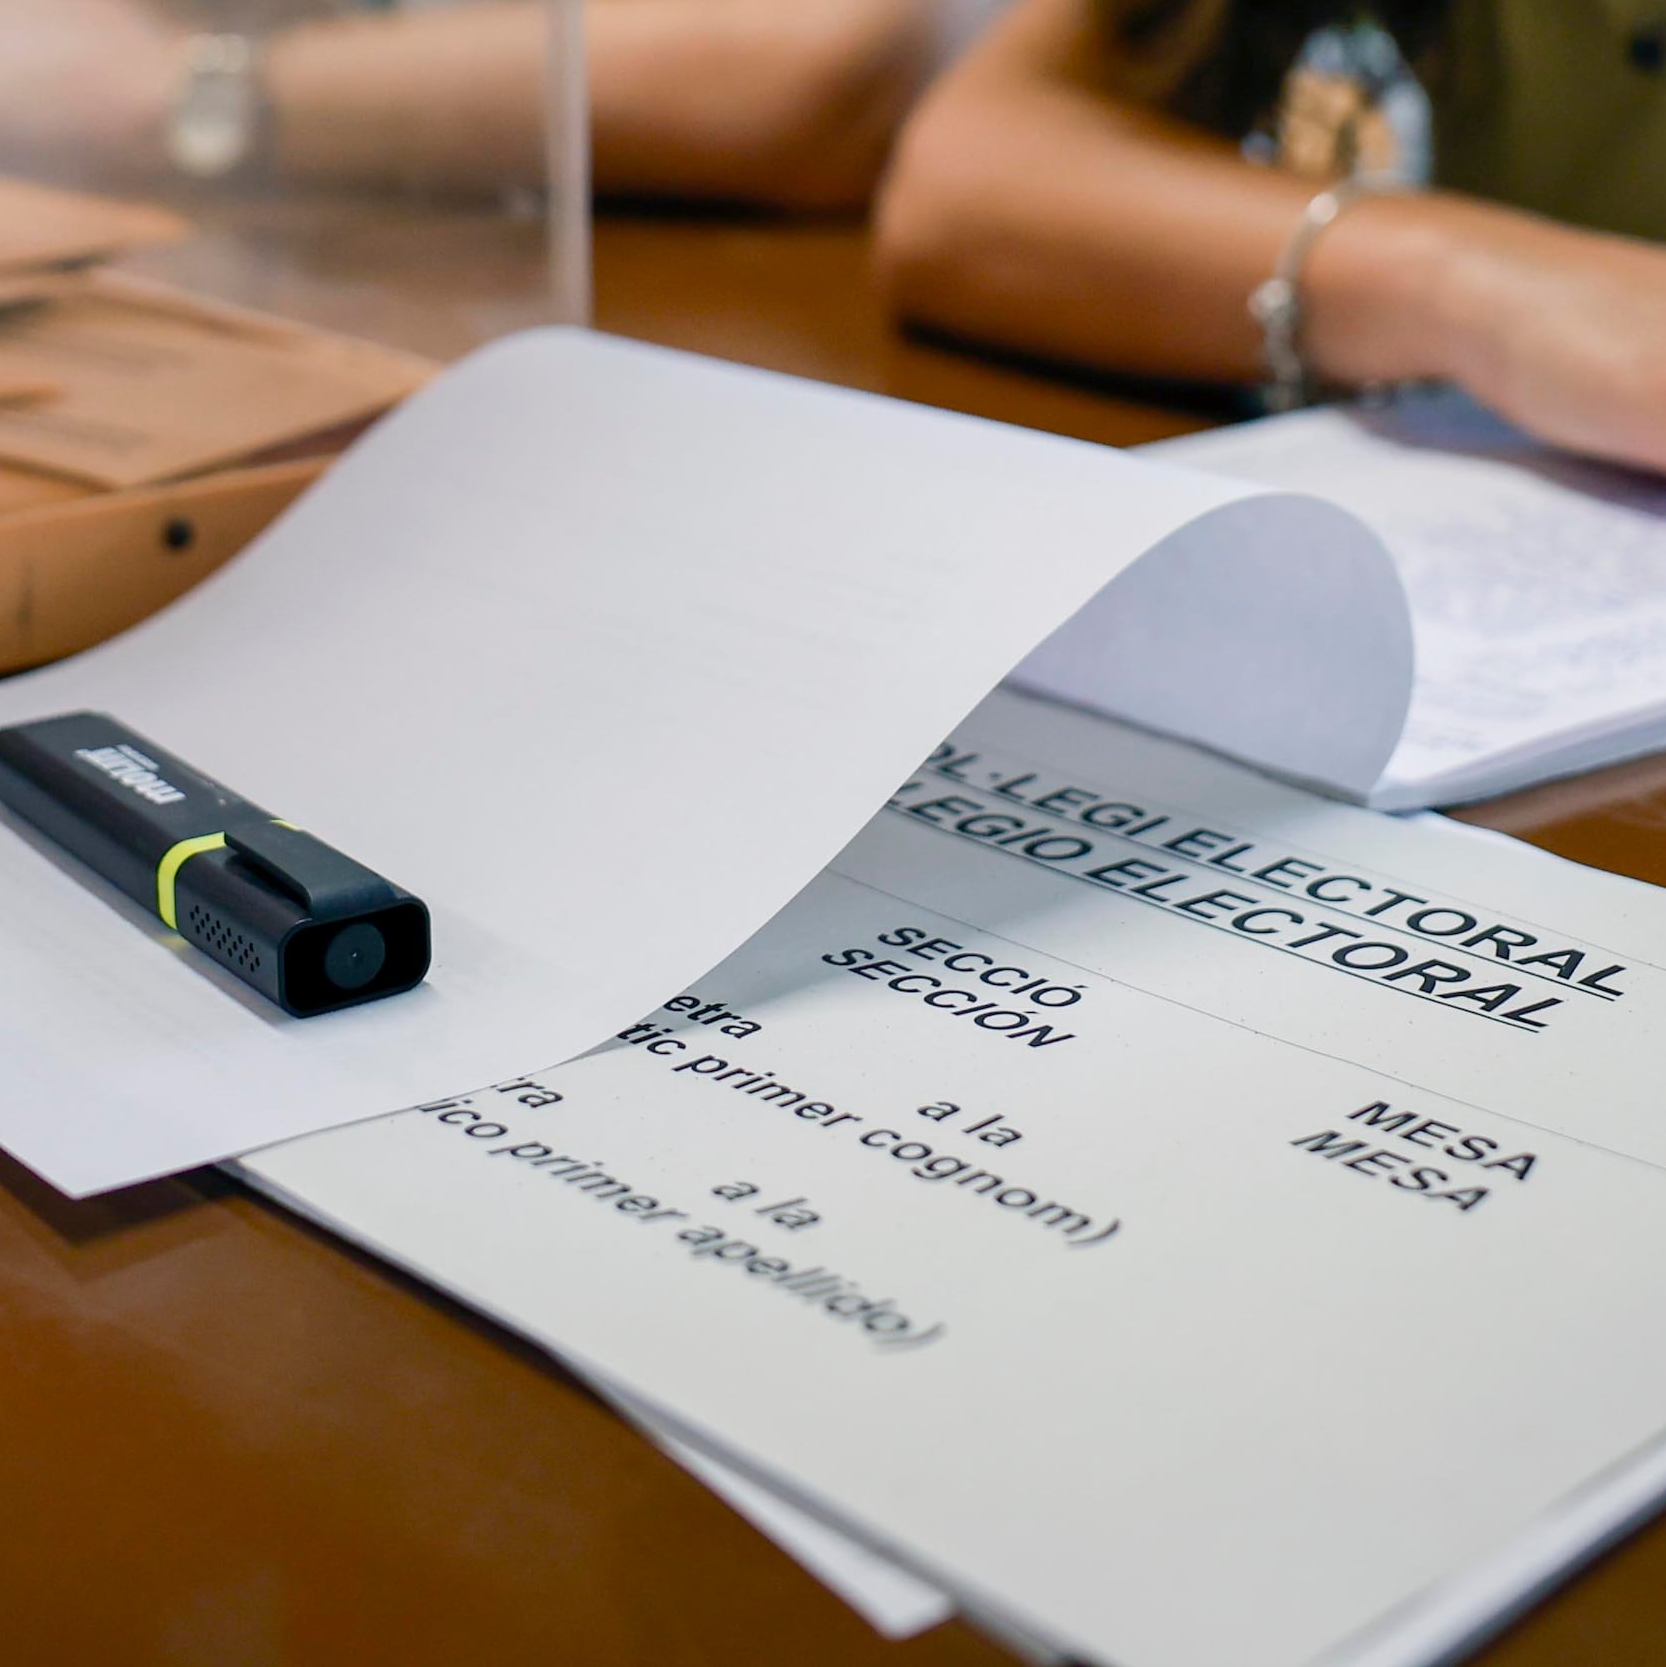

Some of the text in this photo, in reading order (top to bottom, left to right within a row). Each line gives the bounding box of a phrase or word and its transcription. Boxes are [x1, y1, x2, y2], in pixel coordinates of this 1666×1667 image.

[1082, 856, 1565, 1030] ELECTORAL
[1162, 827, 1628, 997] ELECTORAL
[821, 947, 1077, 1049] SECCIÓN
[876, 925, 1090, 1009] SECCIÓ
[662, 994, 763, 1039] etra
[489, 1076, 564, 1108] ra
[915, 1100, 1024, 1148] a la
[671, 1053, 863, 1128] primer
[858, 1127, 1122, 1248] cognom)
[1288, 1129, 1490, 1212] MESA
[1344, 1099, 1538, 1181] MESA
[709, 1180, 822, 1230] a la
[486, 1139, 688, 1222] primer
[675, 1224, 948, 1355] apellido)
